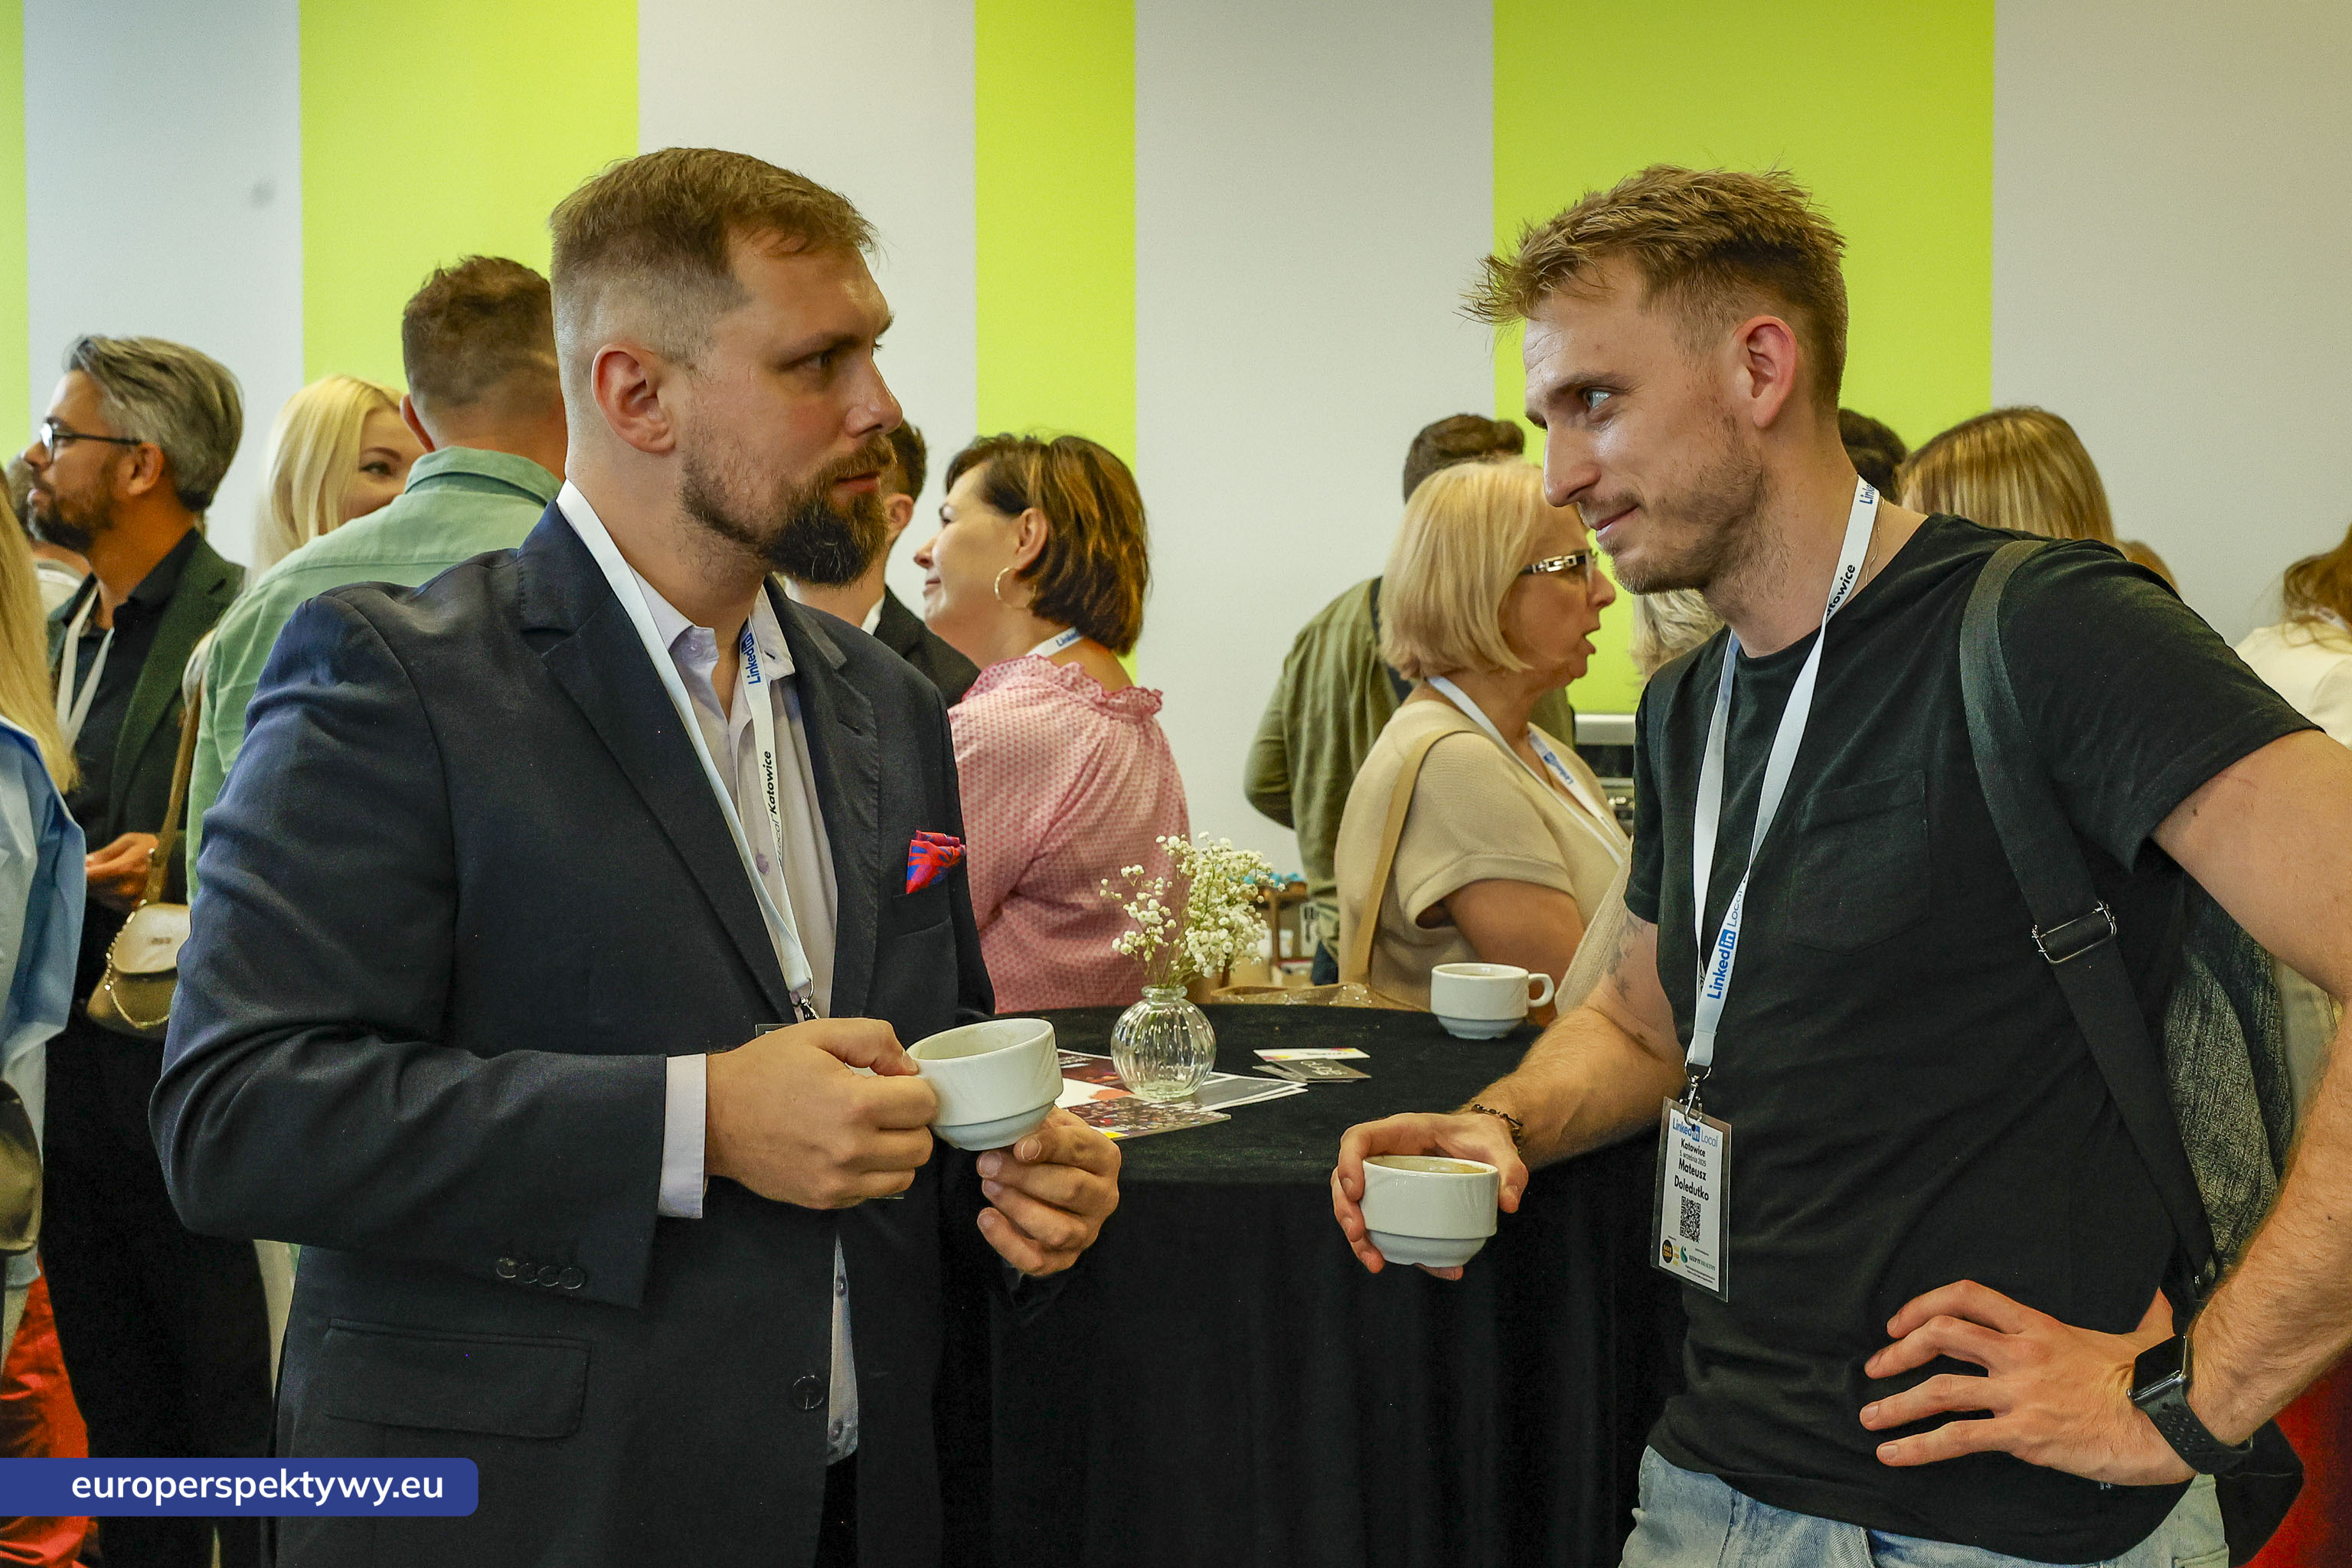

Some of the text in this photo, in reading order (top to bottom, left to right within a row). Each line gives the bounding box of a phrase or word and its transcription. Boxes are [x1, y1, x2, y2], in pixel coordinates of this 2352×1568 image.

[763, 751, 777, 815] Katowice
[1681, 1137, 1706, 1157] Katowice
[1701, 1129, 1718, 1147] Local
[1678, 1158, 1707, 1181] Mateusz
